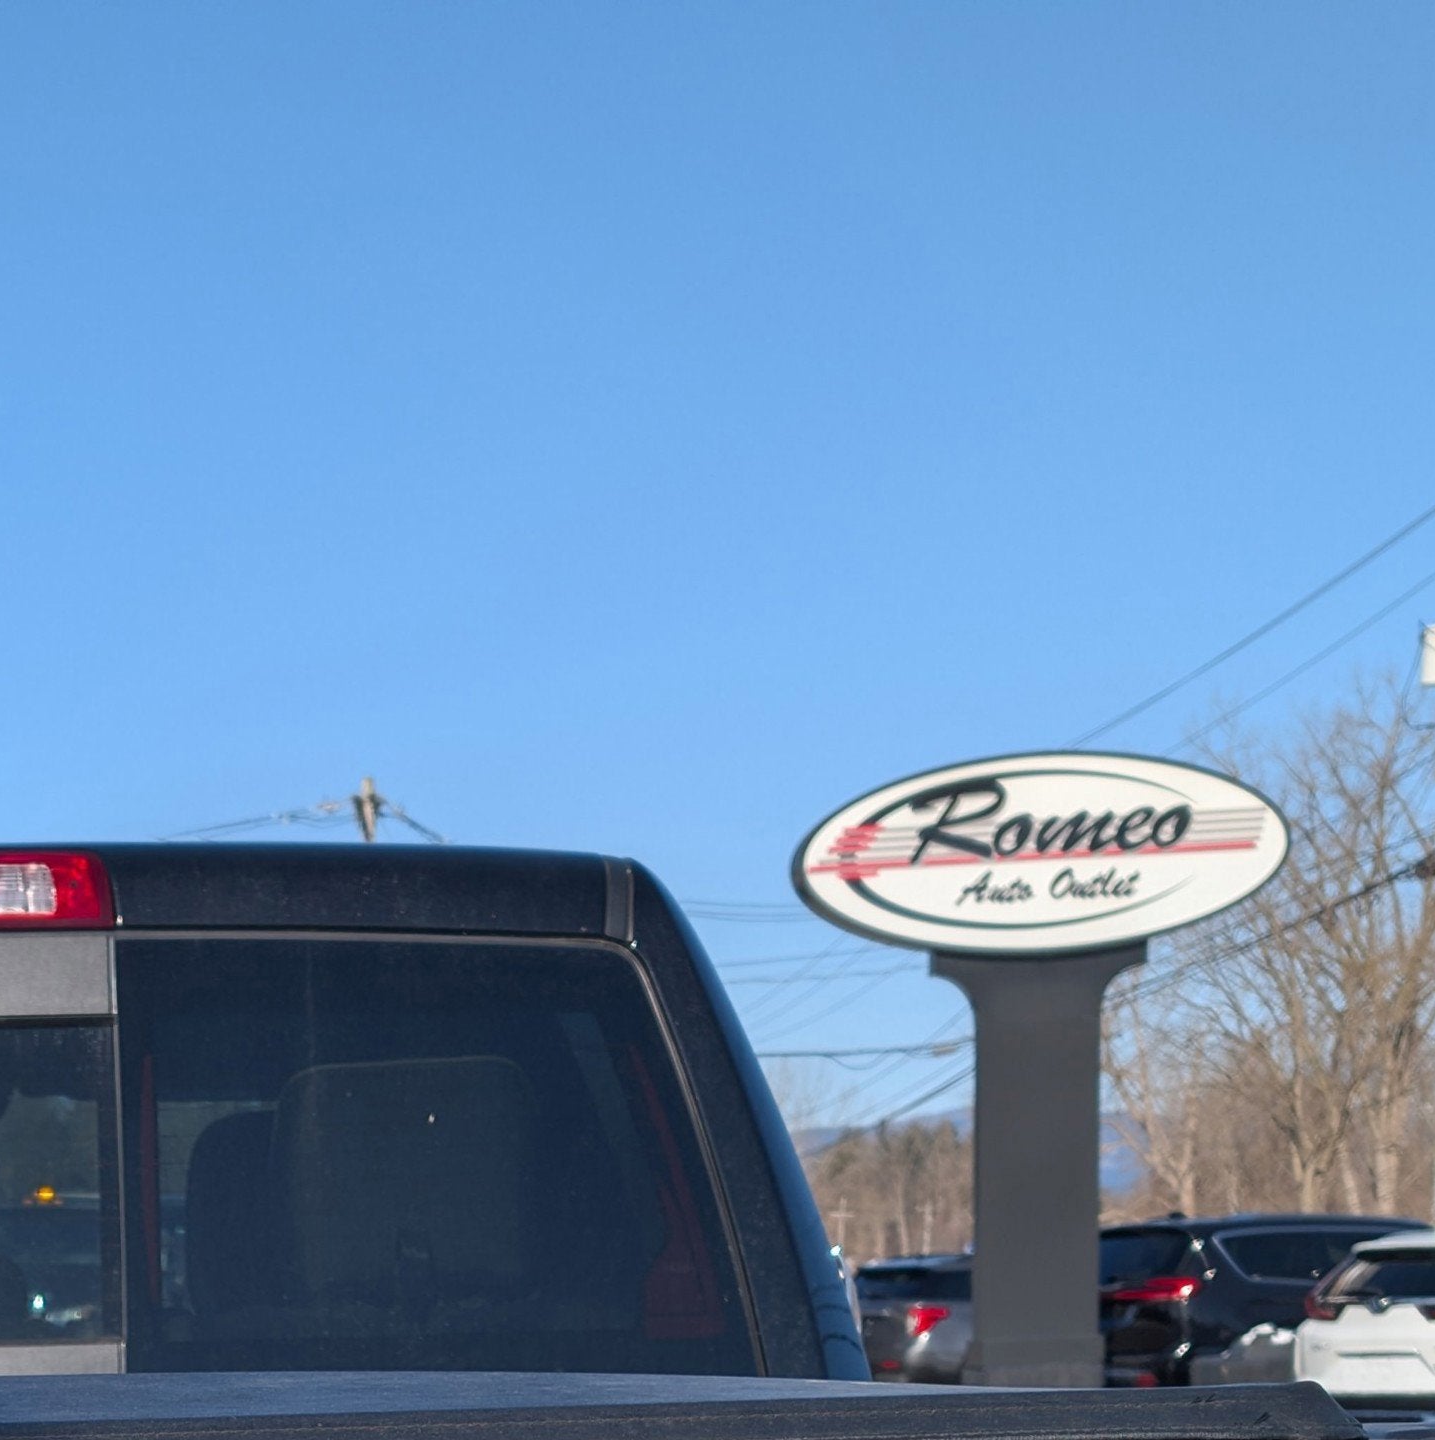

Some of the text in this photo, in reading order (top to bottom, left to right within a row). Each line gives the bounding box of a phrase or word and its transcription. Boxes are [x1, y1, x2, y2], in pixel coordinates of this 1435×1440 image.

[910, 777, 1192, 864] Romeo
[955, 866, 1140, 906] Auto Outlet
